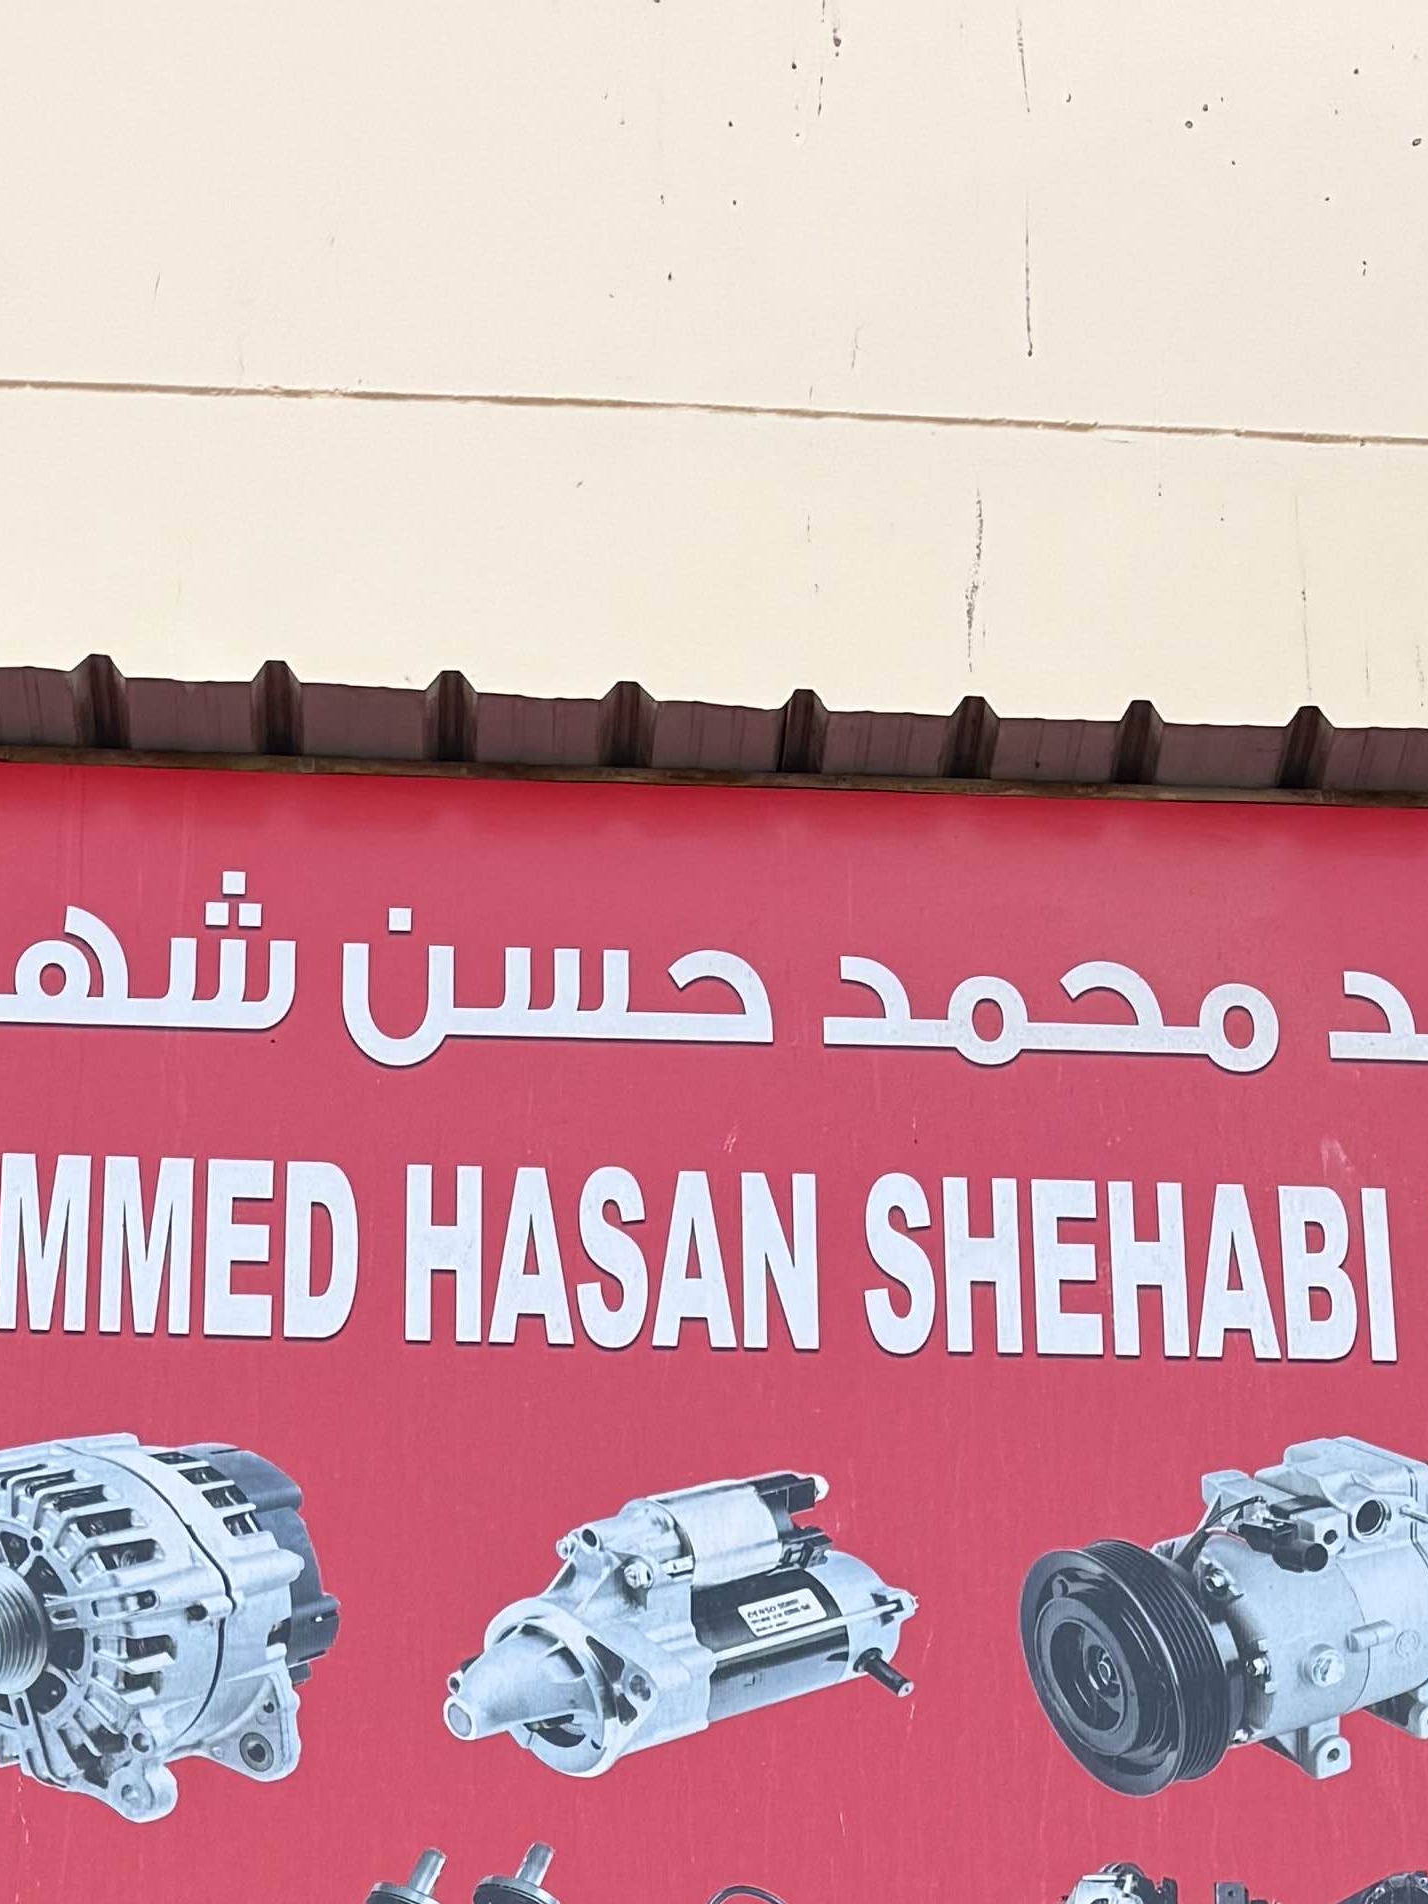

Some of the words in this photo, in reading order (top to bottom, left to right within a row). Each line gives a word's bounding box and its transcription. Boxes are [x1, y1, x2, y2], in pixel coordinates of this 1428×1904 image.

[340, 906, 776, 1067] حسن
[822, 955, 1281, 1075] محمد
[405, 1164, 821, 1352] HASAN
[864, 1172, 1399, 1365] SHEHABI
